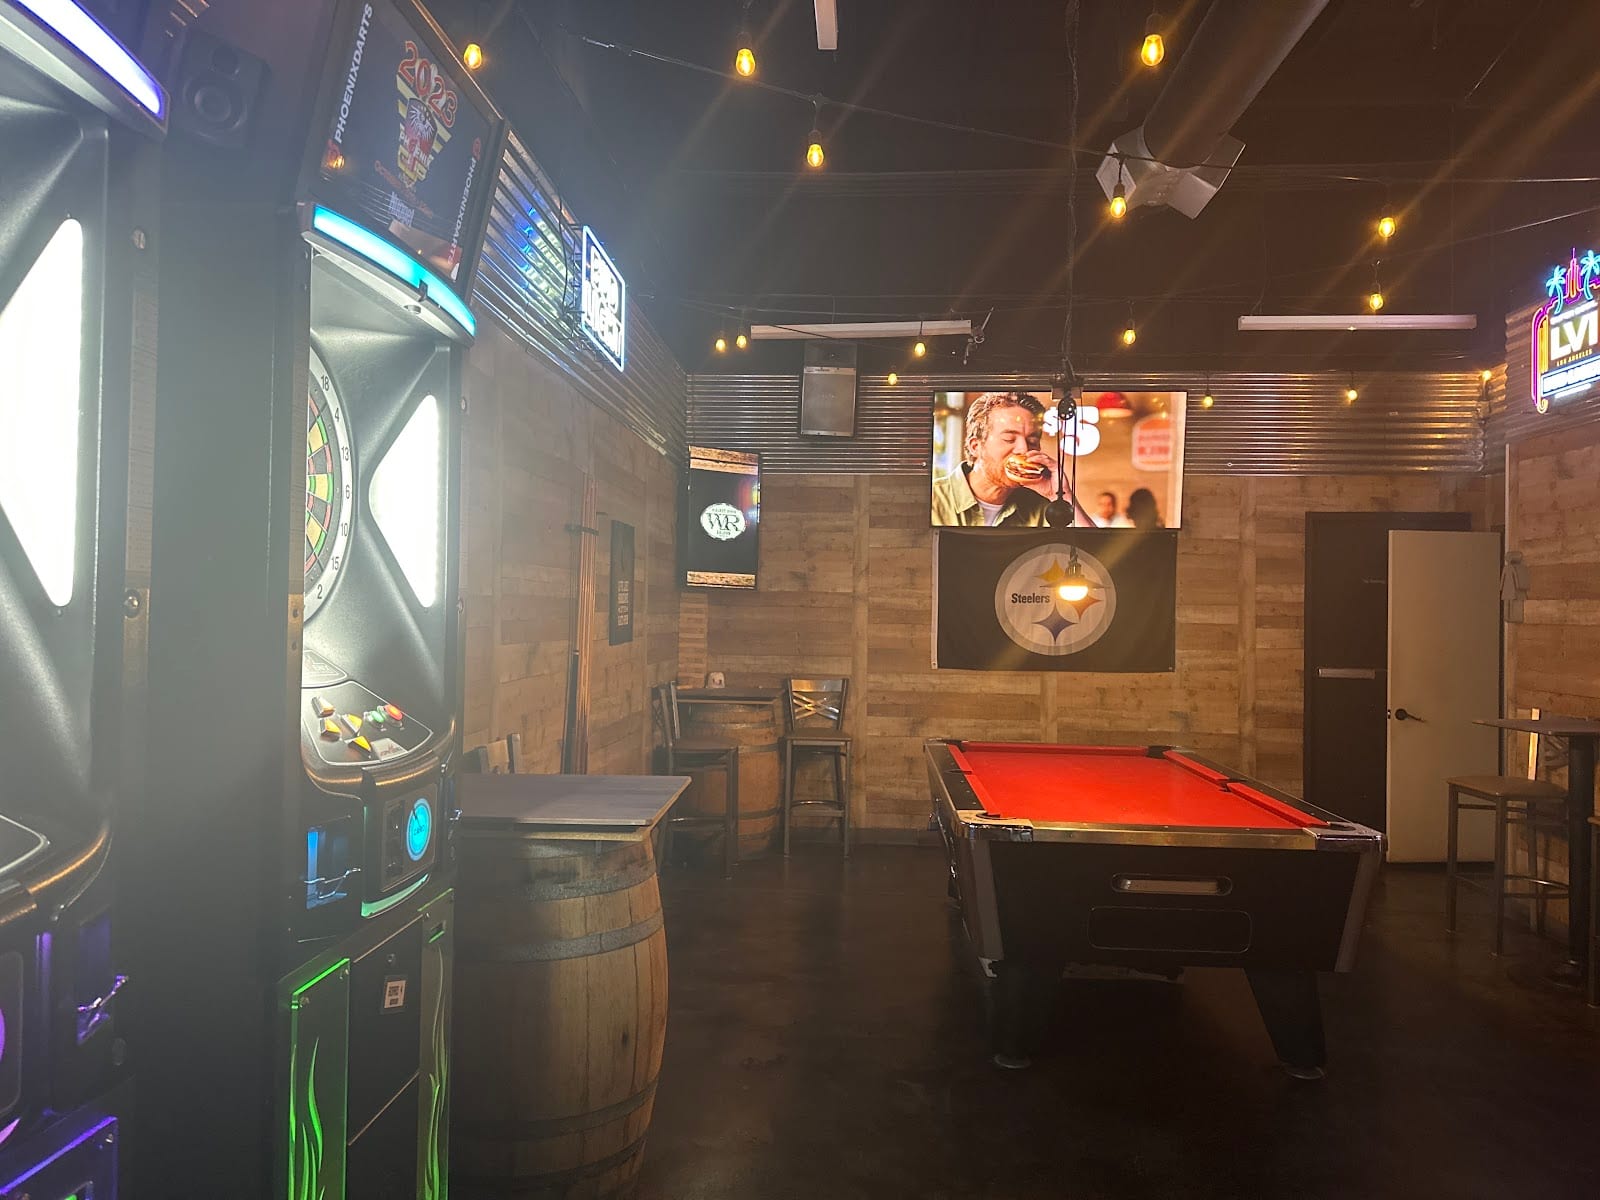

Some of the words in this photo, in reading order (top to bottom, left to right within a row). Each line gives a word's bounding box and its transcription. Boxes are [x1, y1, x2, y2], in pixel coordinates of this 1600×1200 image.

[334, 3, 373, 144] PHOENIXDARTS
[398, 40, 458, 128] 2023
[447, 157, 477, 266] PHOENIXDARTS
[1550, 310, 1598, 360] LVI
[320, 374, 330, 392] 18
[334, 407, 341, 423] 4
[341, 446, 350, 462] 13
[345, 484, 351, 500] 6
[340, 523, 349, 537] 10
[705, 511, 740, 532] WR
[331, 556, 341, 572] 15
[316, 583, 324, 600] 2
[1011, 592, 1050, 604] Steelers
